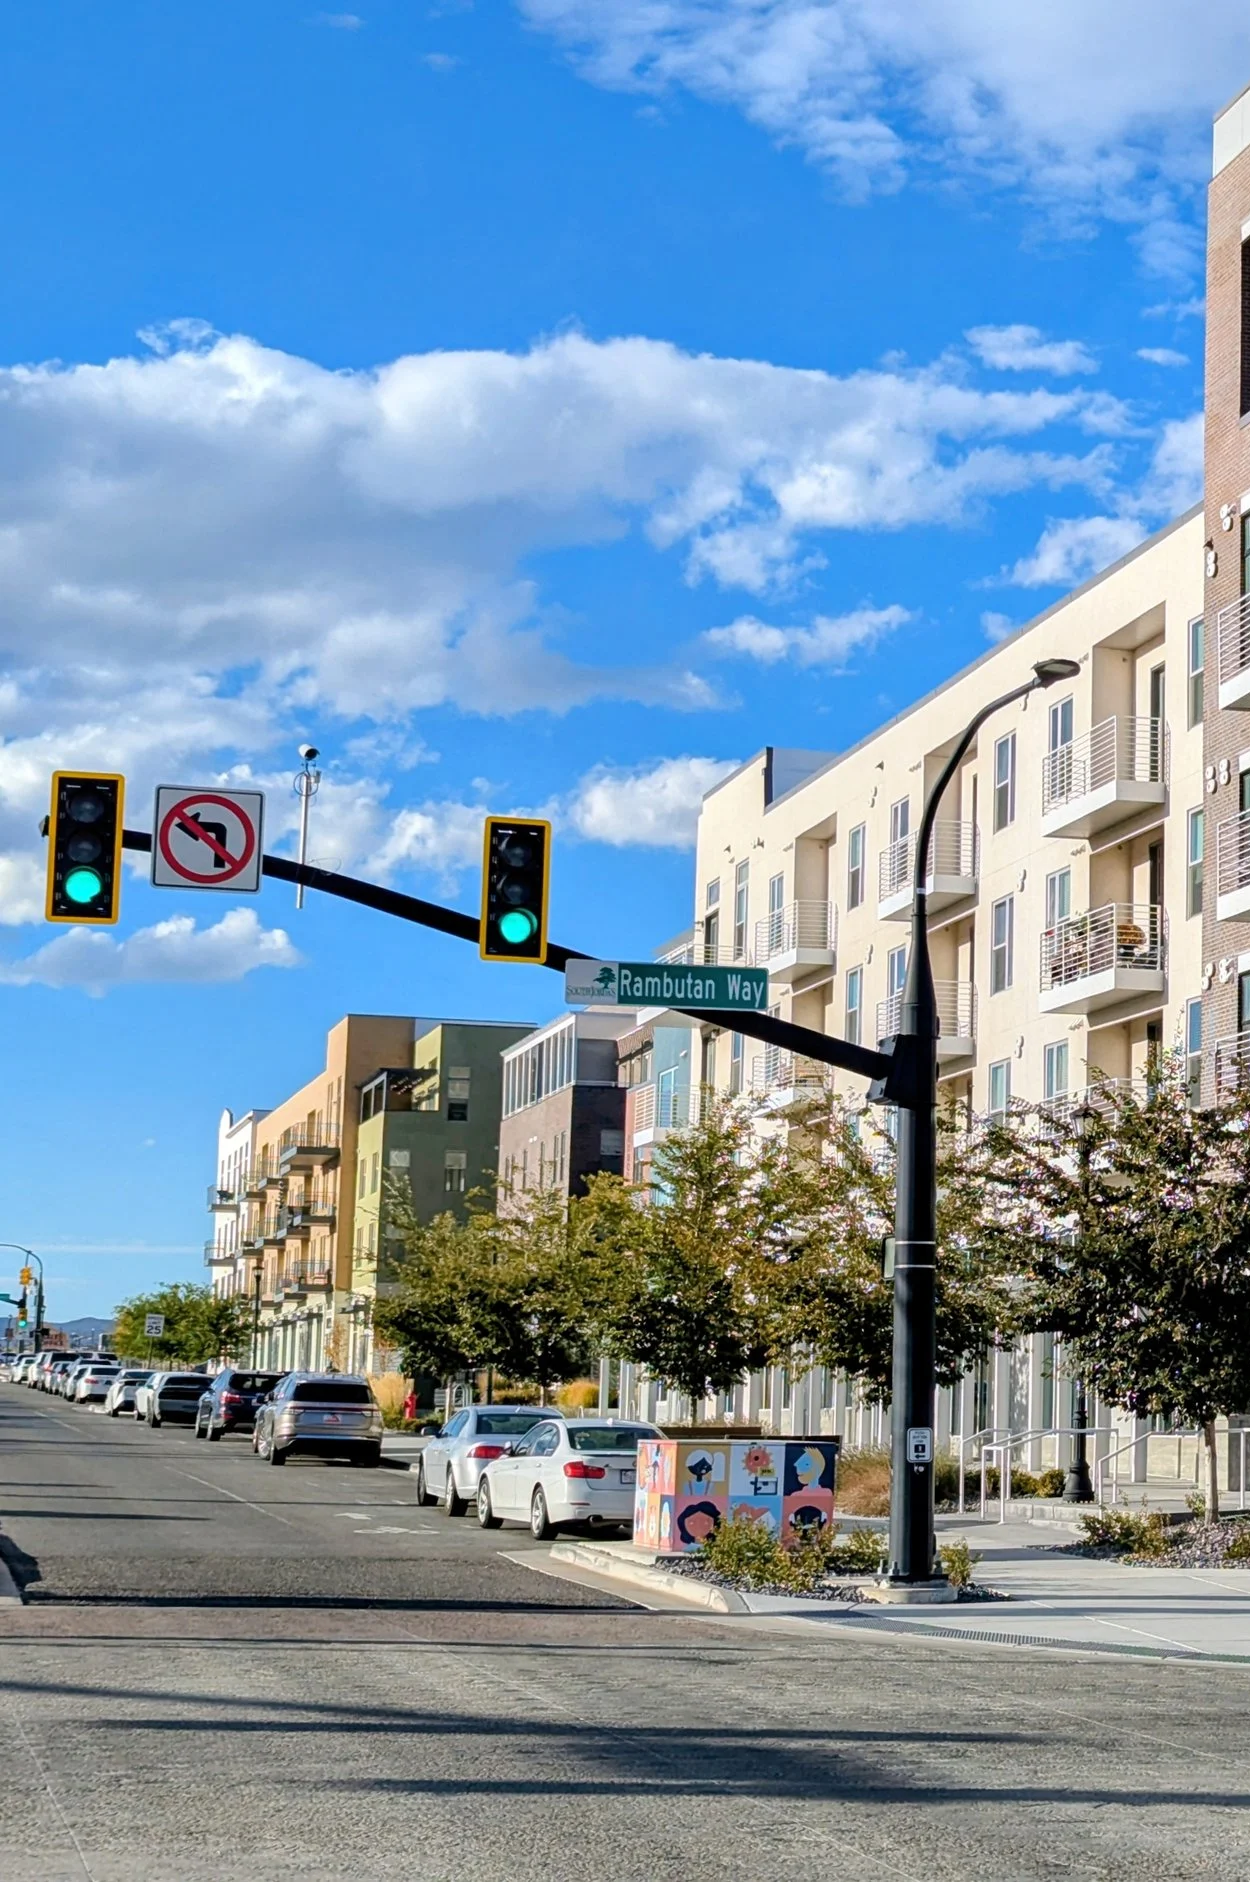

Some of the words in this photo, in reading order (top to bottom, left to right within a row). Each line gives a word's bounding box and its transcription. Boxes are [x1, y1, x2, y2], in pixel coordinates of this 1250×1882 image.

[620, 968, 716, 1000] Rambutan
[727, 973, 765, 1009] Way
[146, 1325, 162, 1336] 25
